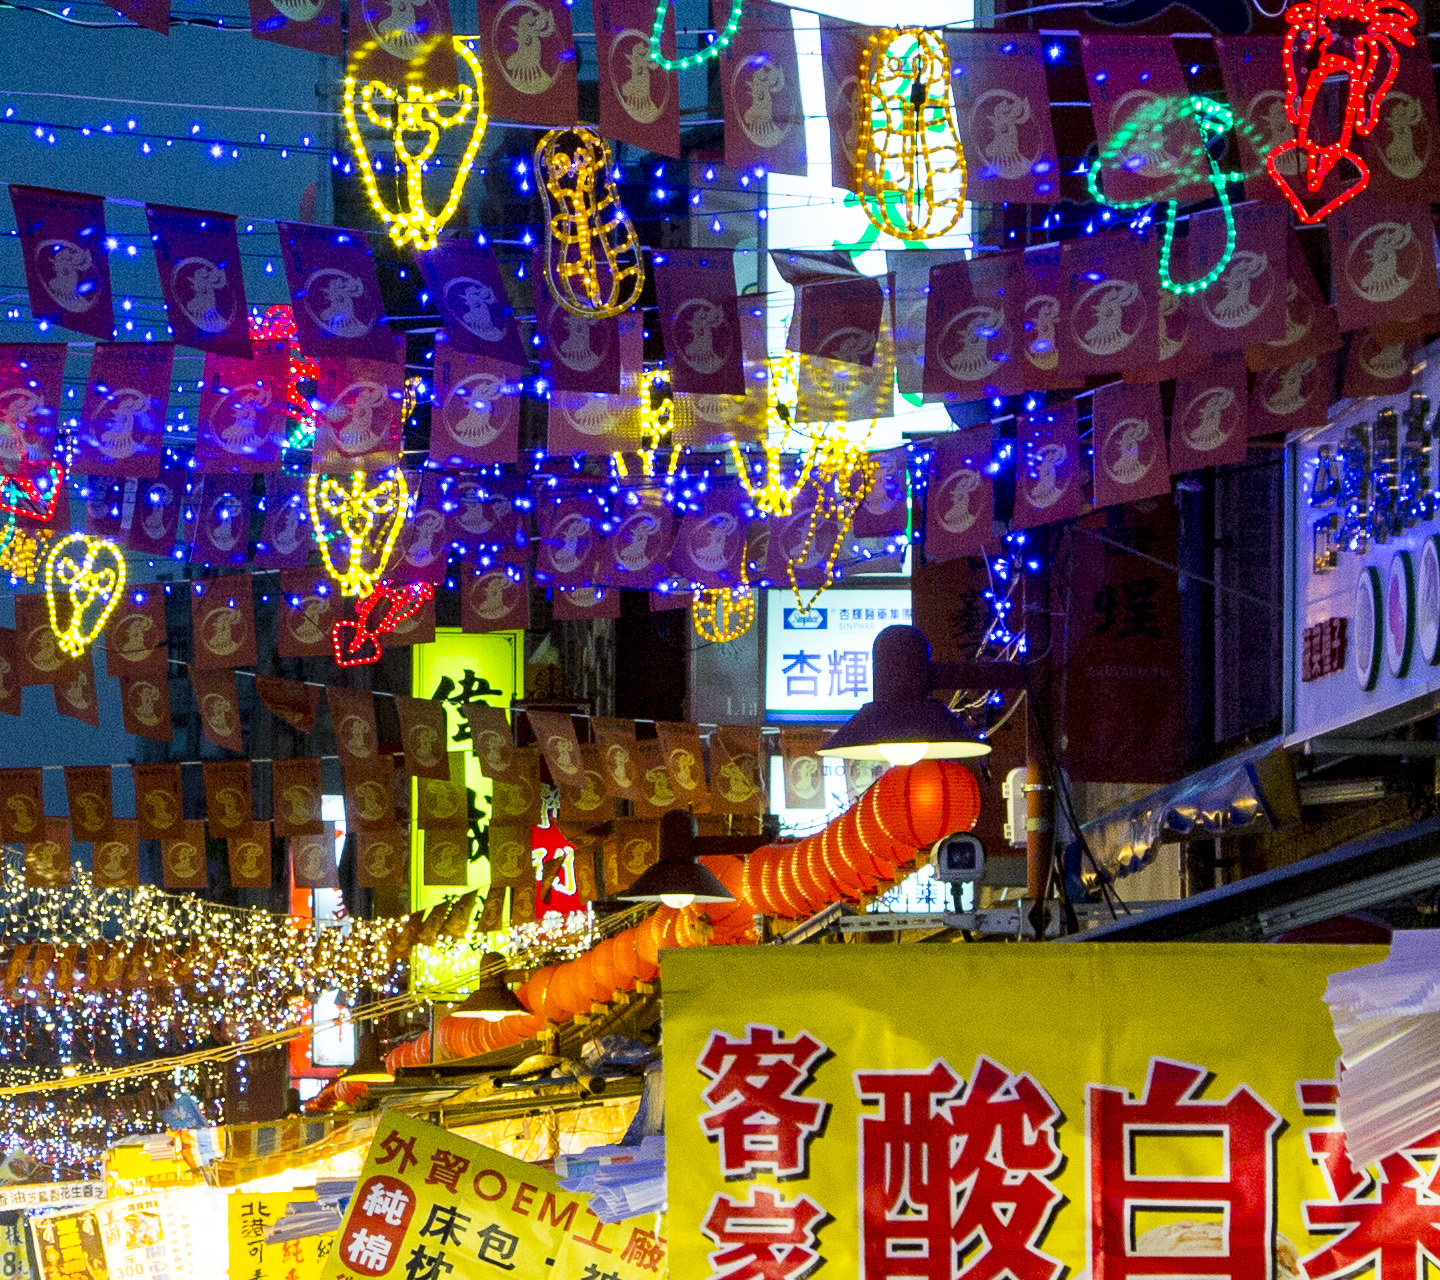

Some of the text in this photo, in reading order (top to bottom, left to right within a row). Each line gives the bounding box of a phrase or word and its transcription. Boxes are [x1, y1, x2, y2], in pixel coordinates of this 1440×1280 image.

[782, 649, 869, 697] 杏輝
[347, 1182, 408, 1273] 純棉
[420, 1204, 519, 1271] 床包
[116, 1263, 144, 1279] 300
